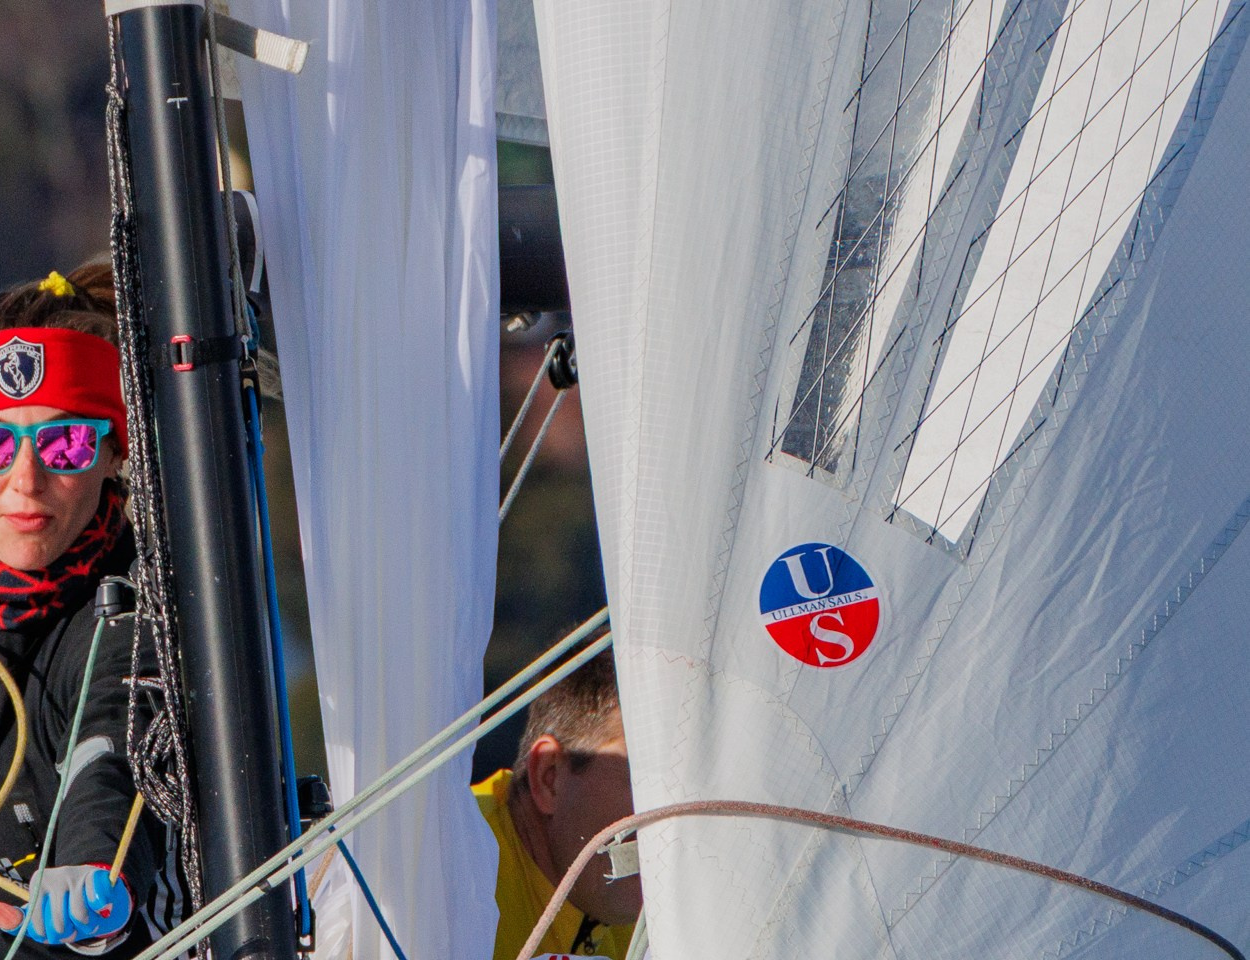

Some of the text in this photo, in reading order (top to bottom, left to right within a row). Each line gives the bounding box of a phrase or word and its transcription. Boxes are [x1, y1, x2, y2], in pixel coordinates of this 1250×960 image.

[778, 547, 834, 600] U
[771, 592, 862, 621] ULLMAN SAILS
[810, 610, 854, 666] S
